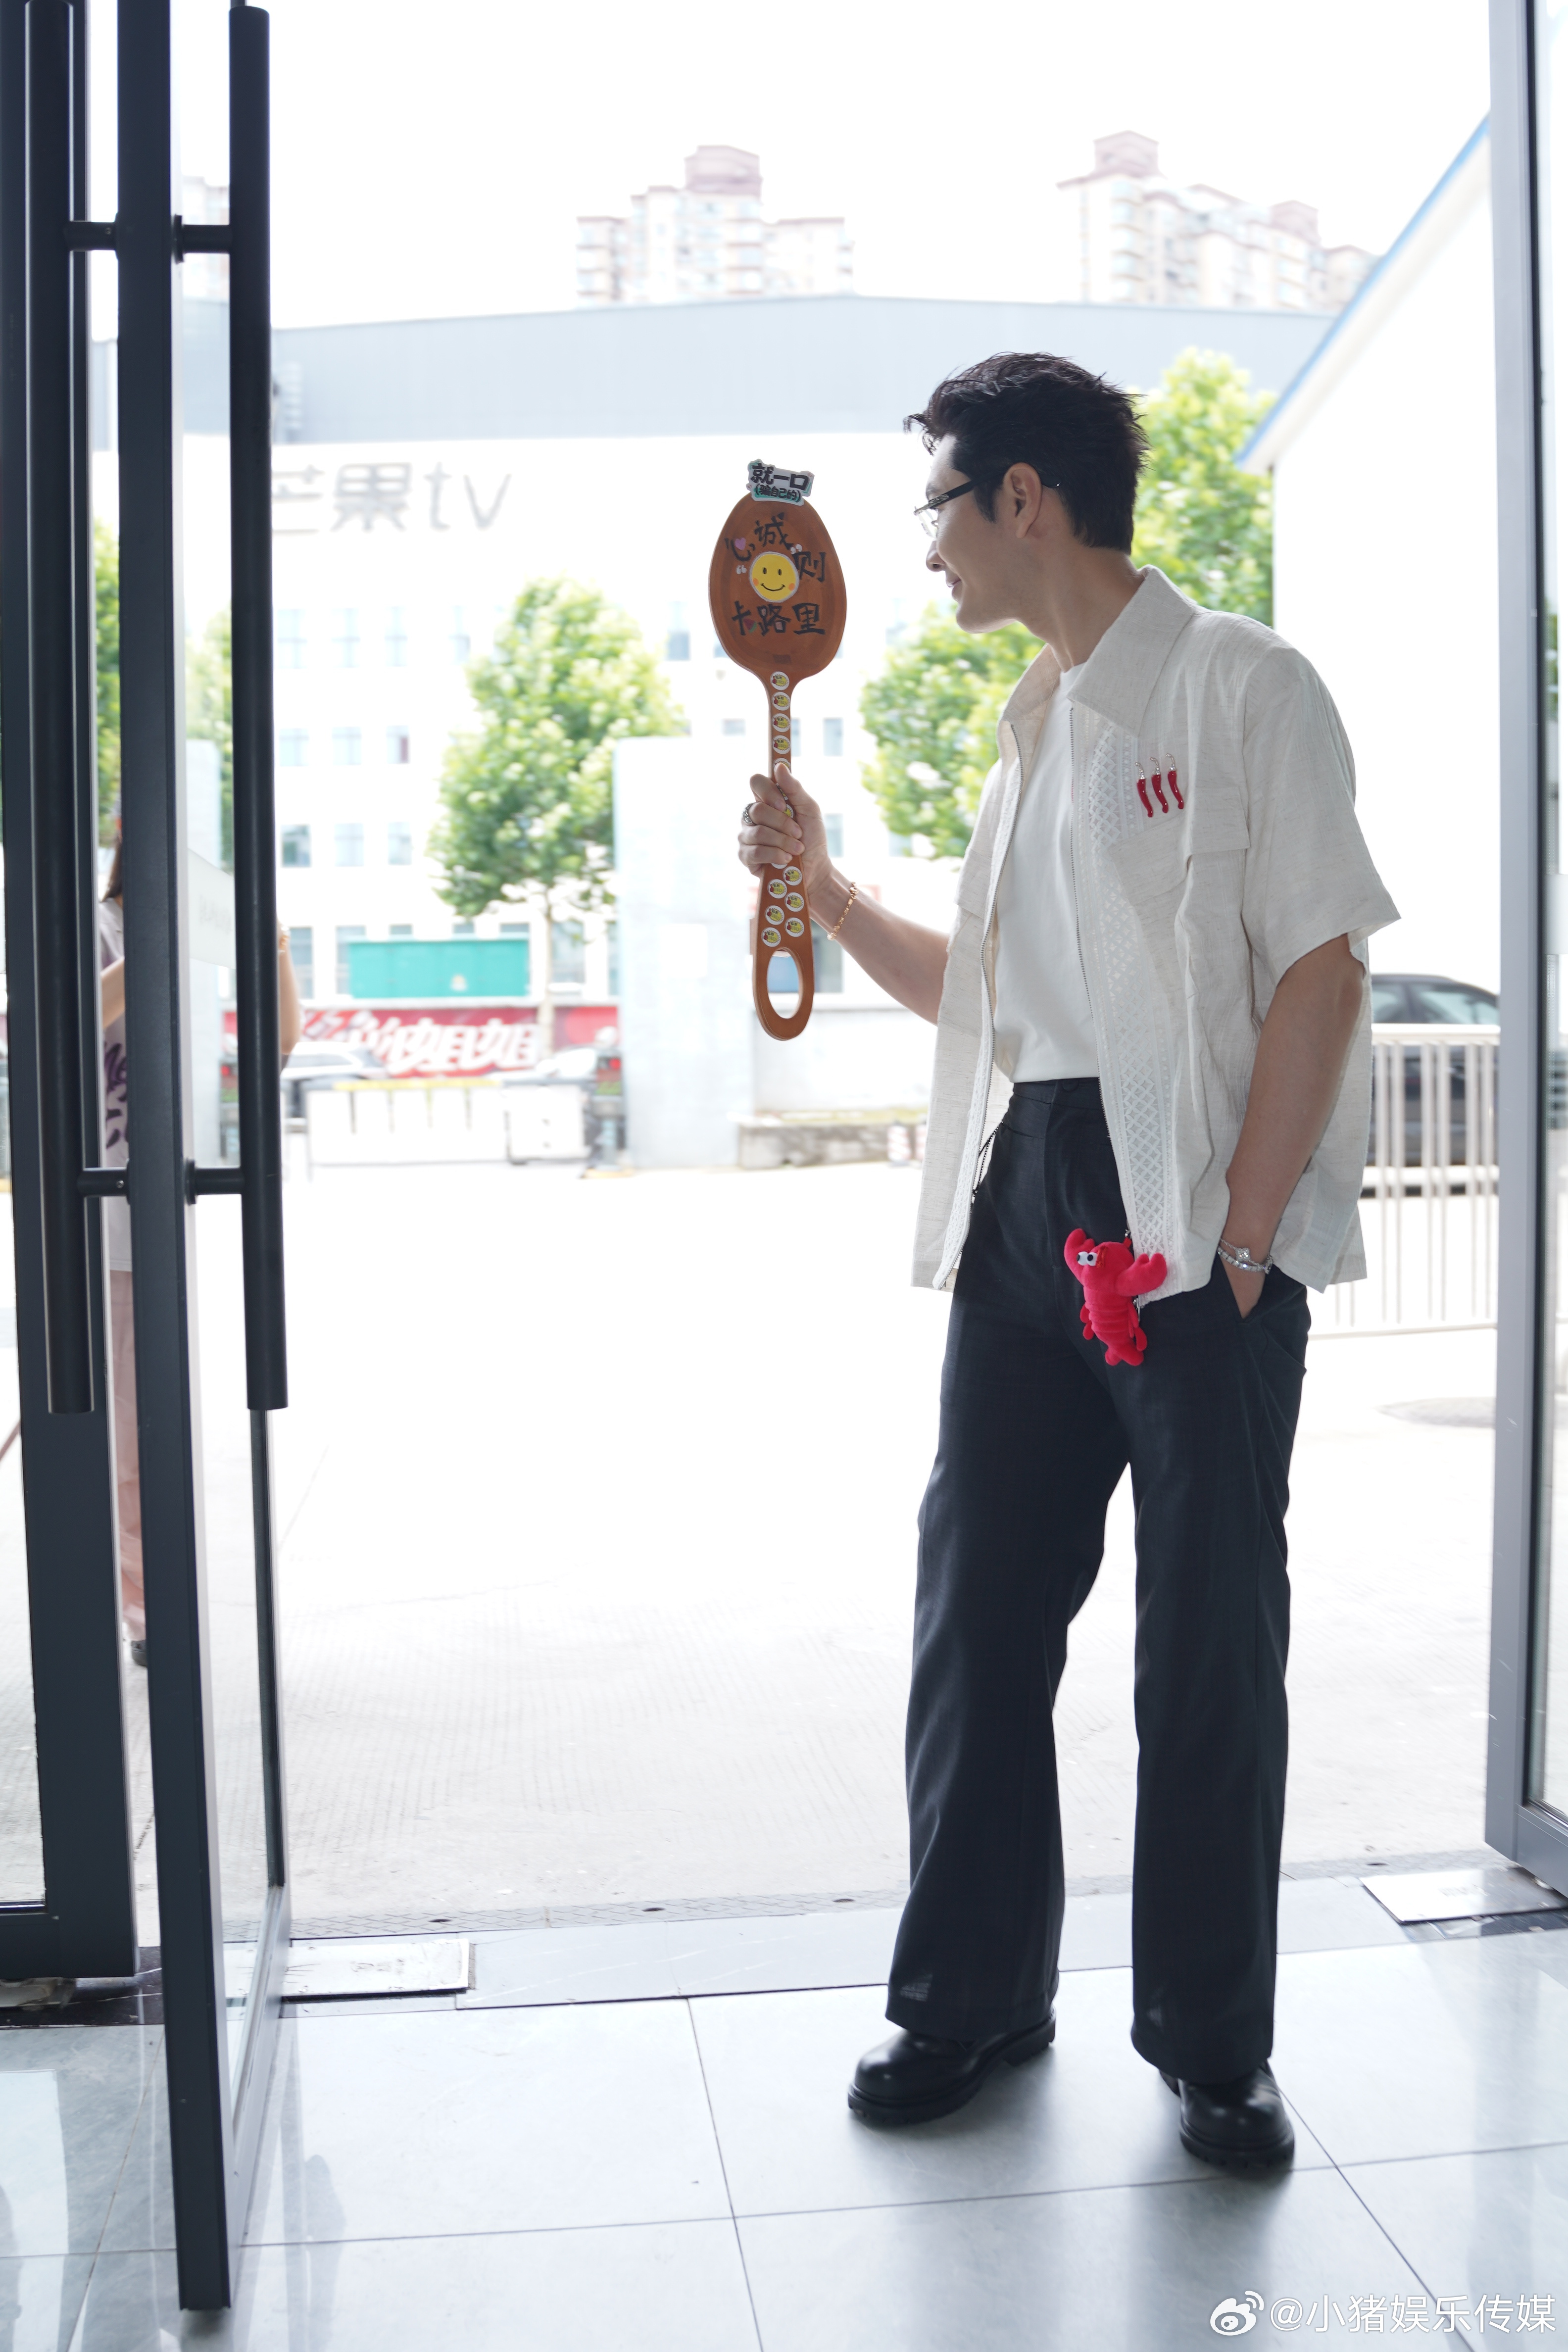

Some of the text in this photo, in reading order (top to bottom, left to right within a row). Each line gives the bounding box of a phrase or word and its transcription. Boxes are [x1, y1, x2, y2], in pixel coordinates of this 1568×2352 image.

[750, 463, 810, 491] 就一口
[732, 600, 826, 637] 卡路里
